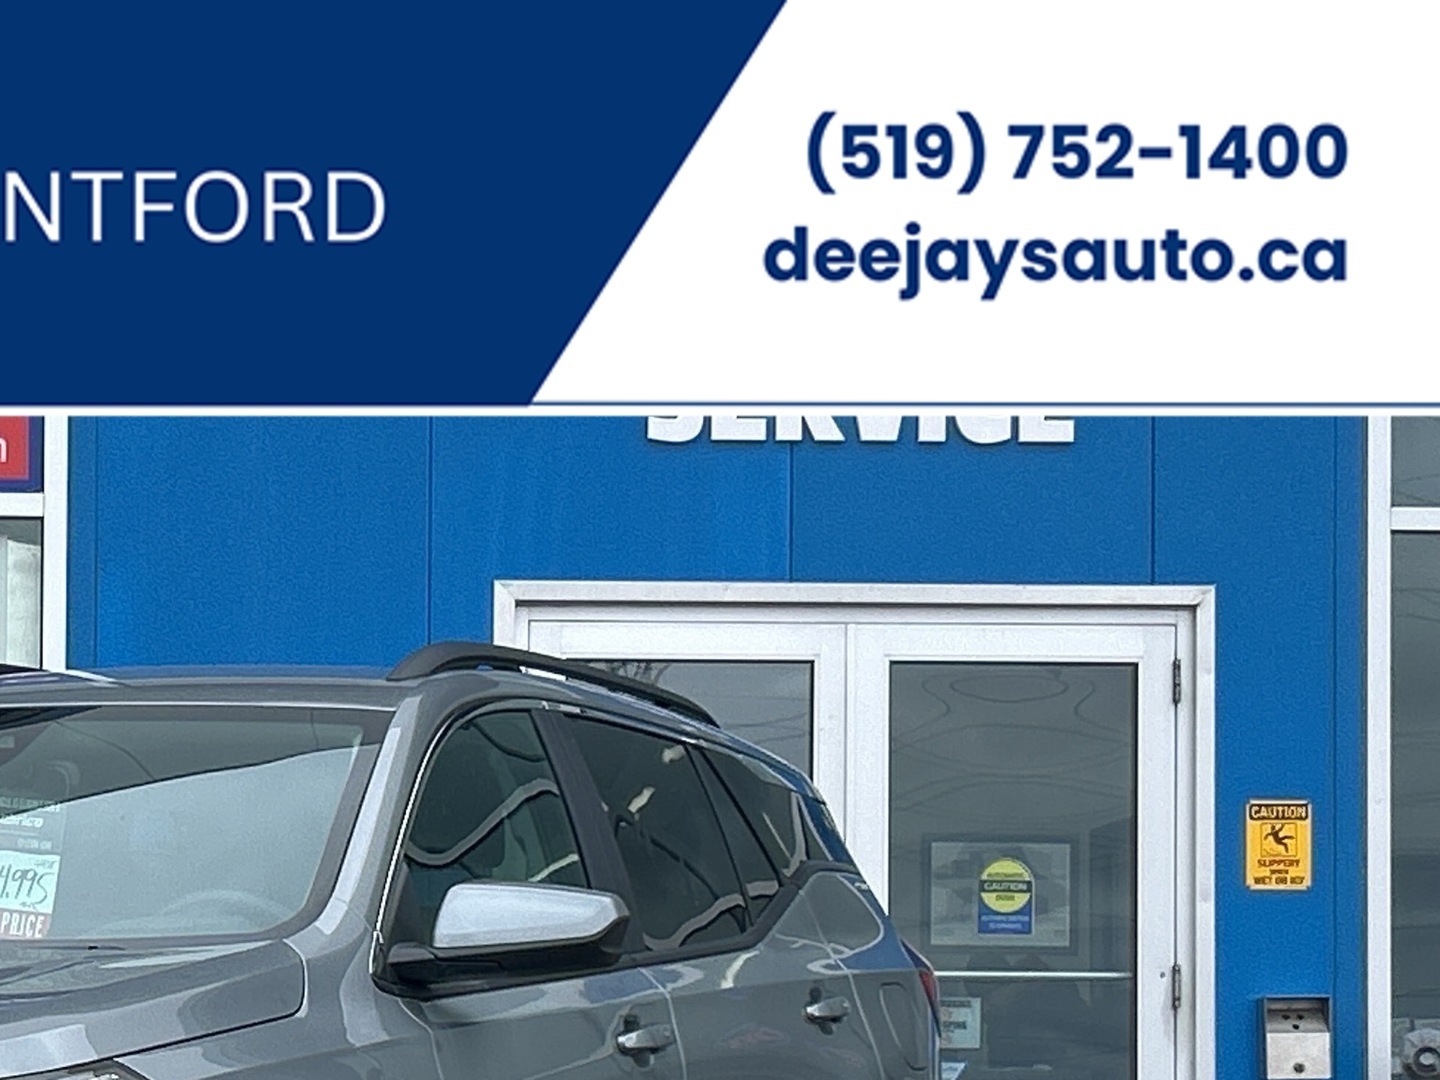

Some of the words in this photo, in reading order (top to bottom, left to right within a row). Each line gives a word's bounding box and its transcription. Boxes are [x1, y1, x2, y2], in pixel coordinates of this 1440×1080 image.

[1251, 806, 1306, 819] CAUTION
[983, 882, 1028, 891] CAUTION
[0, 910, 45, 938] PRICE
